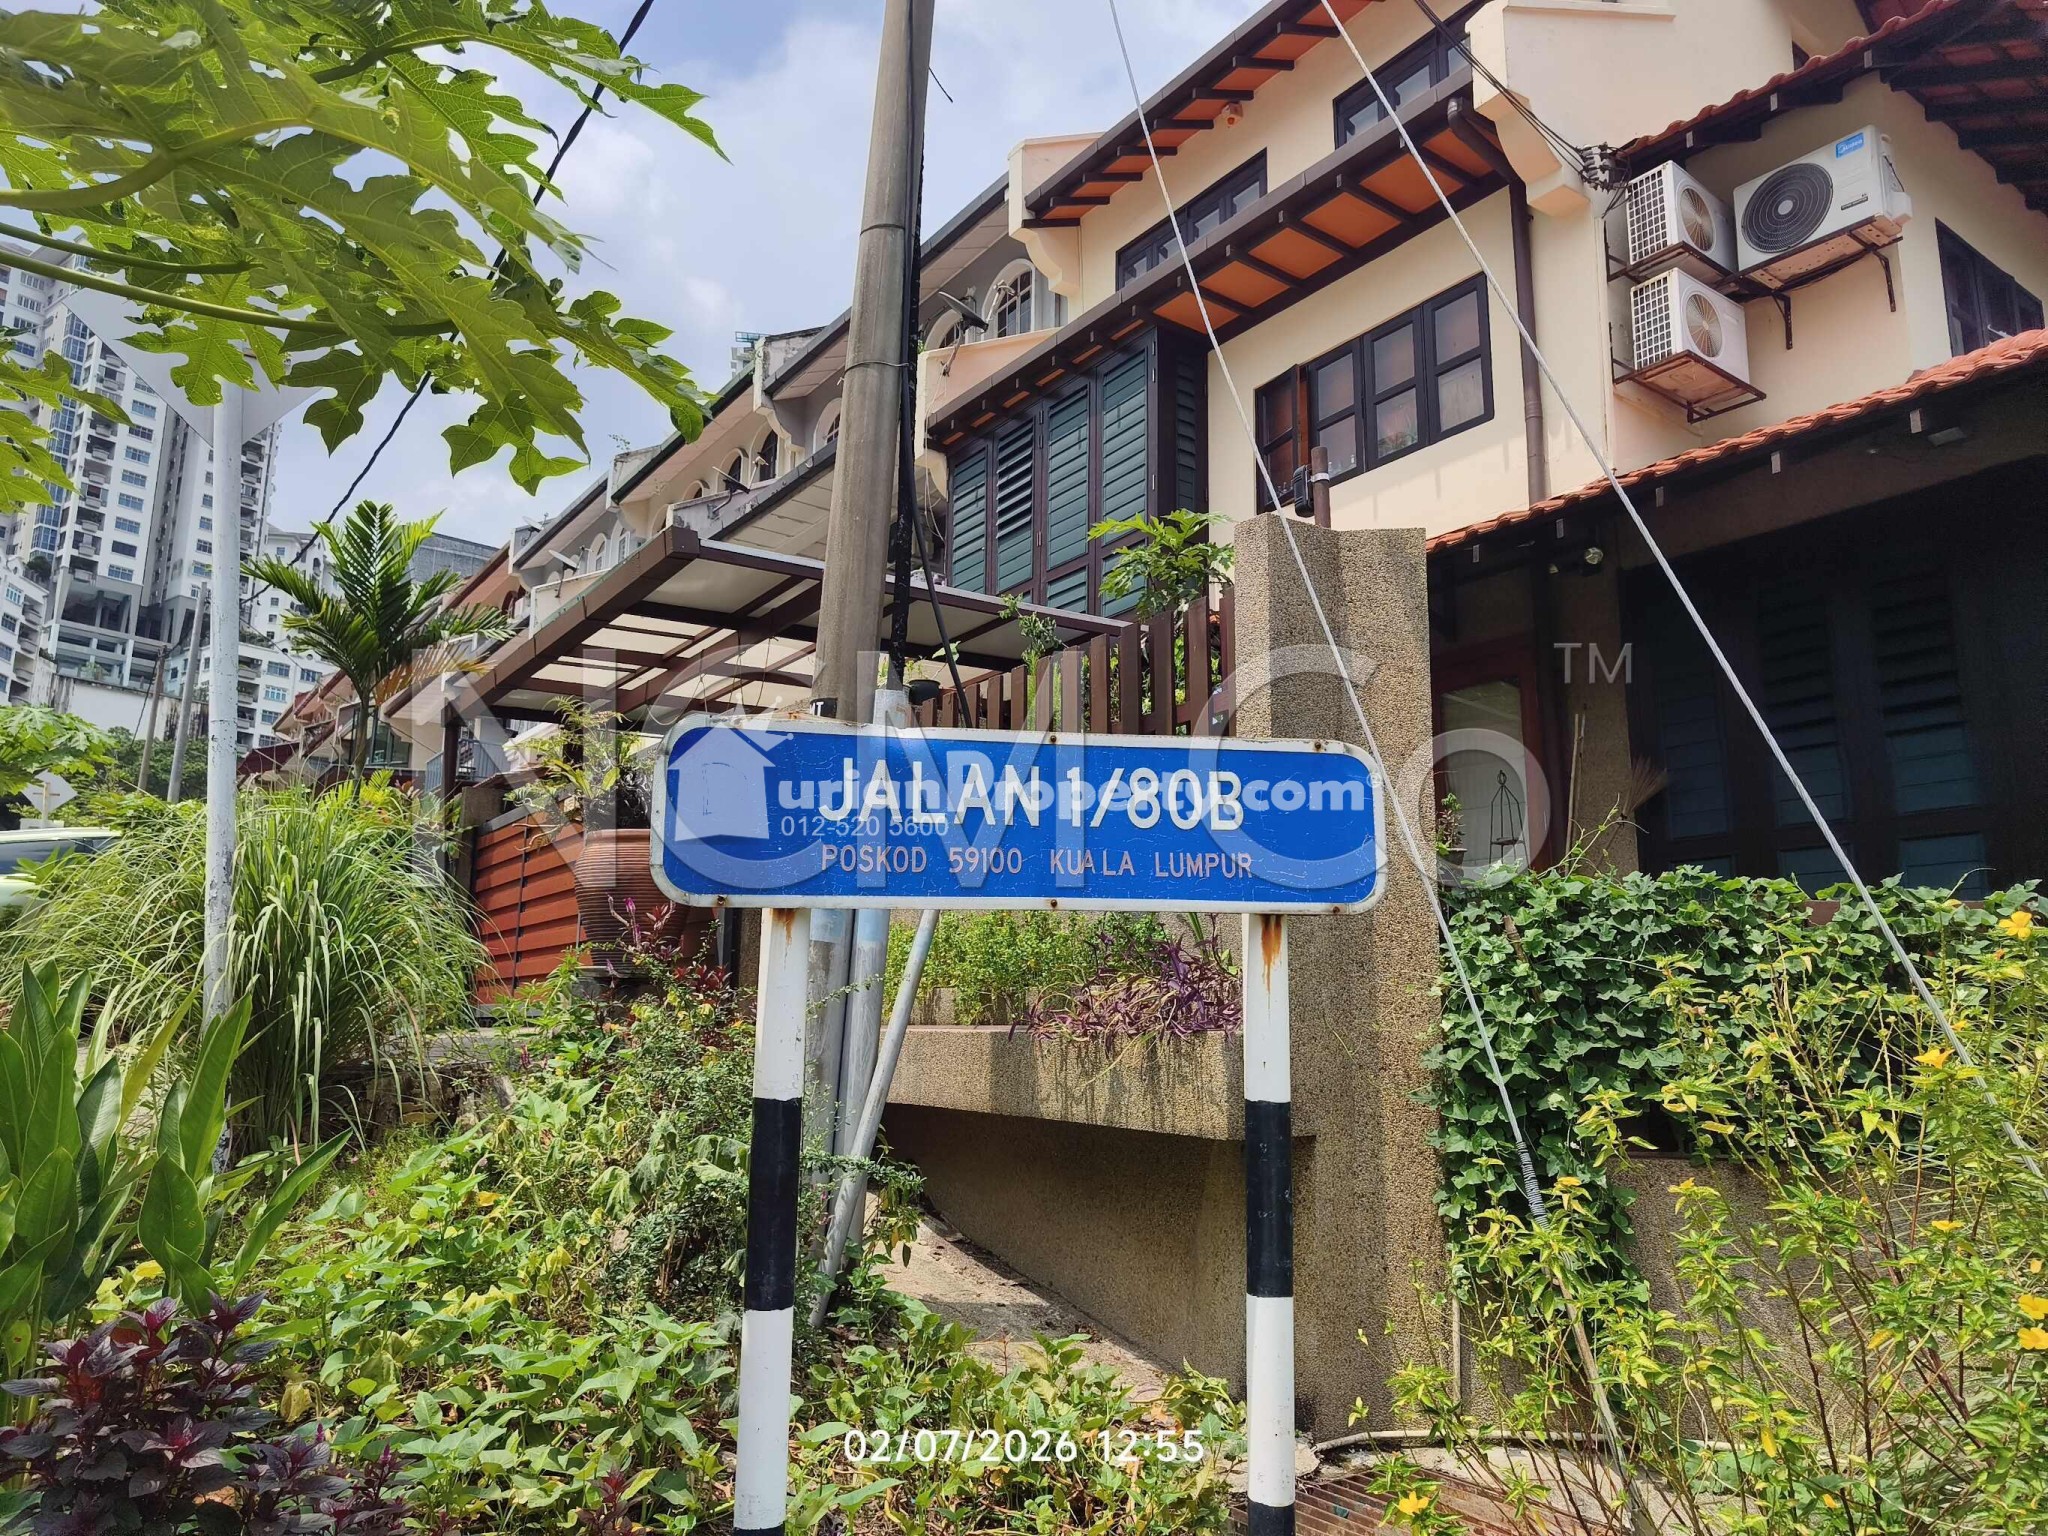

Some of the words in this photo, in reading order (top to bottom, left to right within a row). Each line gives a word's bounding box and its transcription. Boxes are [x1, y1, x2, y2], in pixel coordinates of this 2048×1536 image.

[819, 757, 1040, 827] JALAN
[1066, 766, 1244, 831] 1/80B
[821, 844, 927, 874] POSKOD
[949, 847, 1022, 875] 59100
[1050, 849, 1135, 877] KUALA
[1155, 852, 1253, 879] LUMPUR
